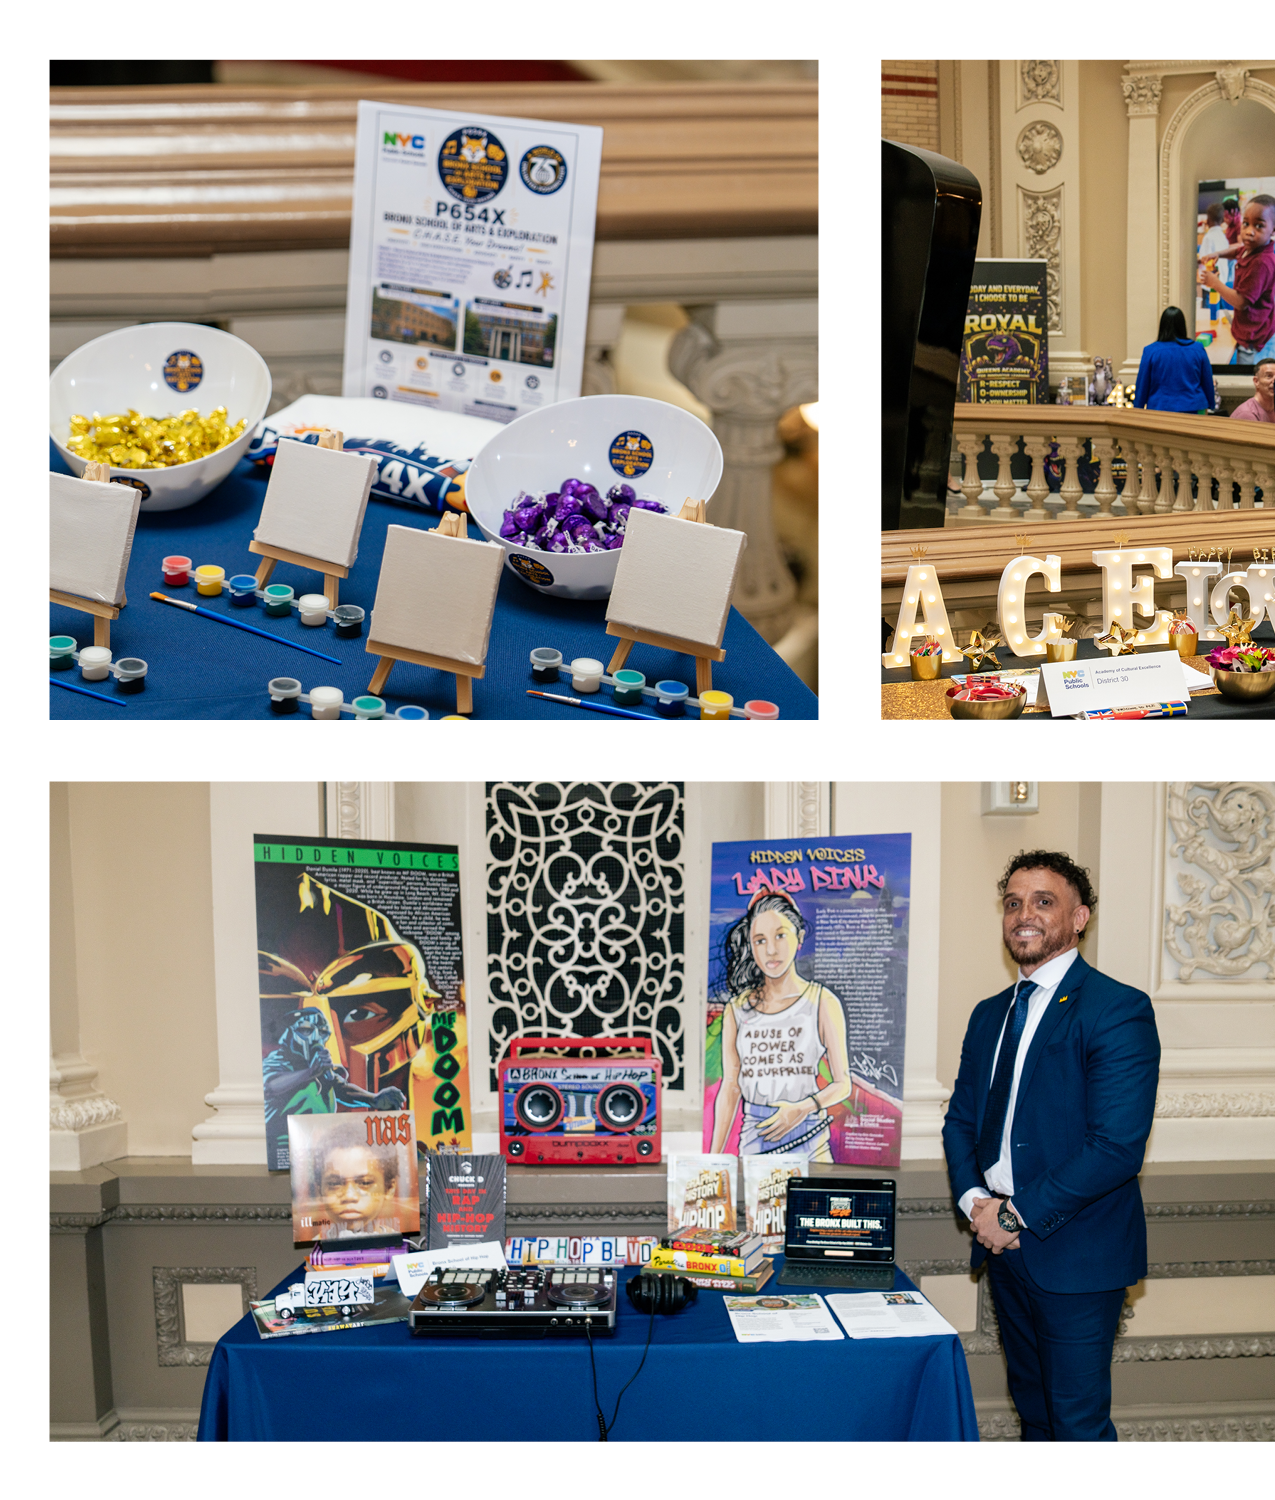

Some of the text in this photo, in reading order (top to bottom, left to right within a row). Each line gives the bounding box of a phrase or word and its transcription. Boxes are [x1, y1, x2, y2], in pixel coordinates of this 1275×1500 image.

[384, 131, 425, 149] NYC
[436, 202, 507, 226] P654X
[415, 216, 449, 229] SCHOOL
[465, 223, 486, 235] ARTS
[498, 228, 559, 245] EXPLORATION
[988, 284, 1003, 293] AND
[979, 294, 1029, 303] CHOOSE TO BE
[964, 313, 1043, 335] ROYAL
[1187, 546, 1234, 562] HAPPY
[1062, 670, 1085, 679] NYC
[1096, 675, 1129, 685] District 30
[1065, 682, 1090, 690] Schools
[263, 846, 460, 870] HIDDEN VOICES
[750, 848, 866, 864] HIDDEN VOICES
[732, 864, 886, 896] LADY PINK
[744, 1027, 803, 1039] ABUSE OF
[749, 1041, 796, 1054] POWER
[742, 1053, 805, 1066] COMES AS
[522, 1068, 558, 1080] BRONX
[742, 1066, 815, 1079] NO SURPRISE
[431, 1025, 465, 1136] DOOM
[364, 1113, 411, 1147] nas
[448, 1175, 484, 1183] CHUCK D
[452, 1195, 480, 1205] RAP
[437, 1213, 495, 1223] HIP-HOP
[800, 1217, 883, 1230] THE BRONX BUILT THIS.
[442, 1224, 488, 1232] HISTORY
[511, 1238, 651, 1263] HIP HOP BLVD
[406, 1262, 424, 1270] NYC
[686, 1261, 718, 1272] BRONX
